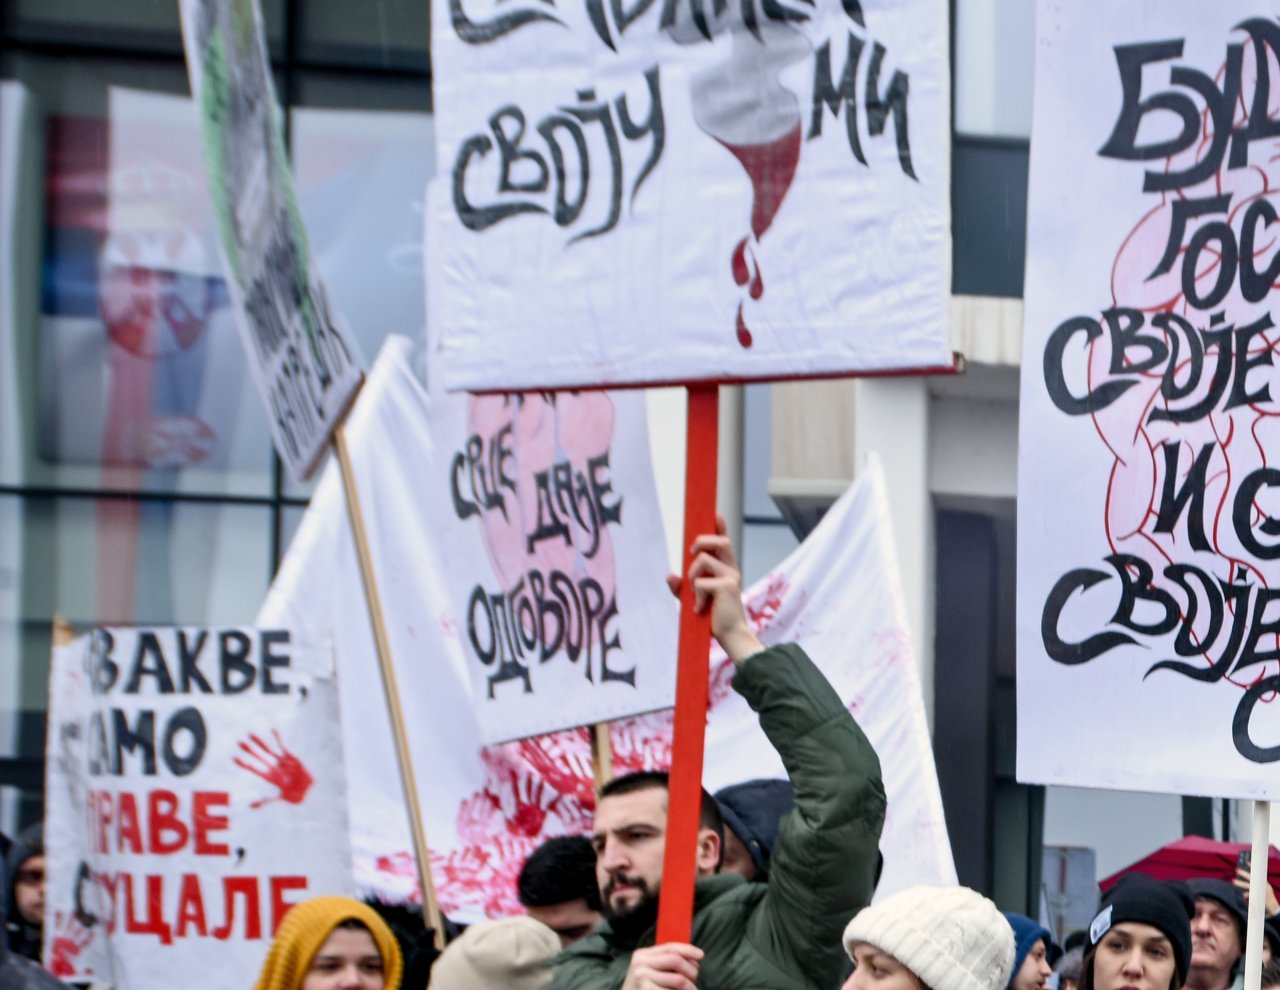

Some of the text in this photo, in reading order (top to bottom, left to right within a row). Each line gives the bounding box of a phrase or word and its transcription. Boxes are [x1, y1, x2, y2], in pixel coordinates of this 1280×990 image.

[452, 63, 666, 248] СВОЈУ
[1043, 306, 1280, 424] СВОЈЕ
[1153, 440, 1216, 557] И
